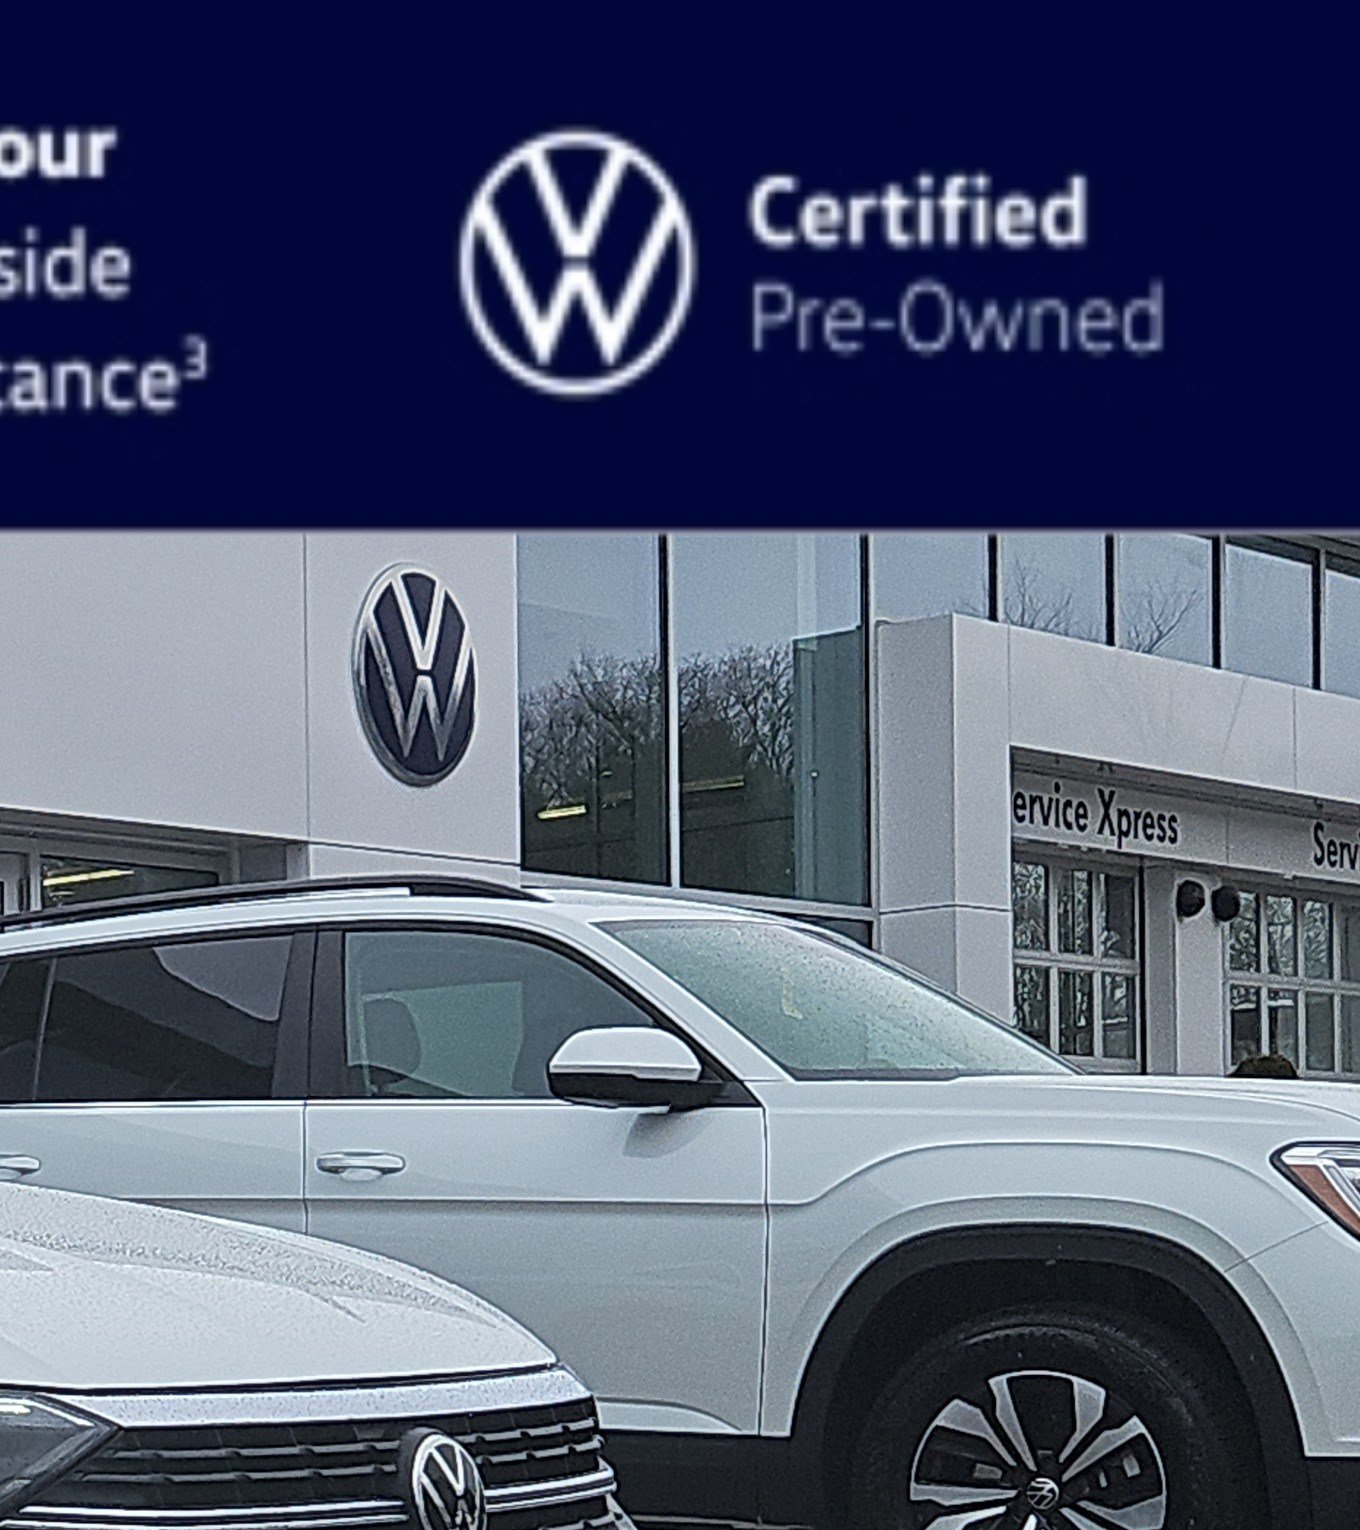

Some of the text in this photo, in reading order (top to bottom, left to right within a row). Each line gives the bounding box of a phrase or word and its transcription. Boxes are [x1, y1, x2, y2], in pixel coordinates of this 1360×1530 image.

[1013, 782, 1178, 849] ervice Xpress
[1313, 821, 1360, 870] Serv
